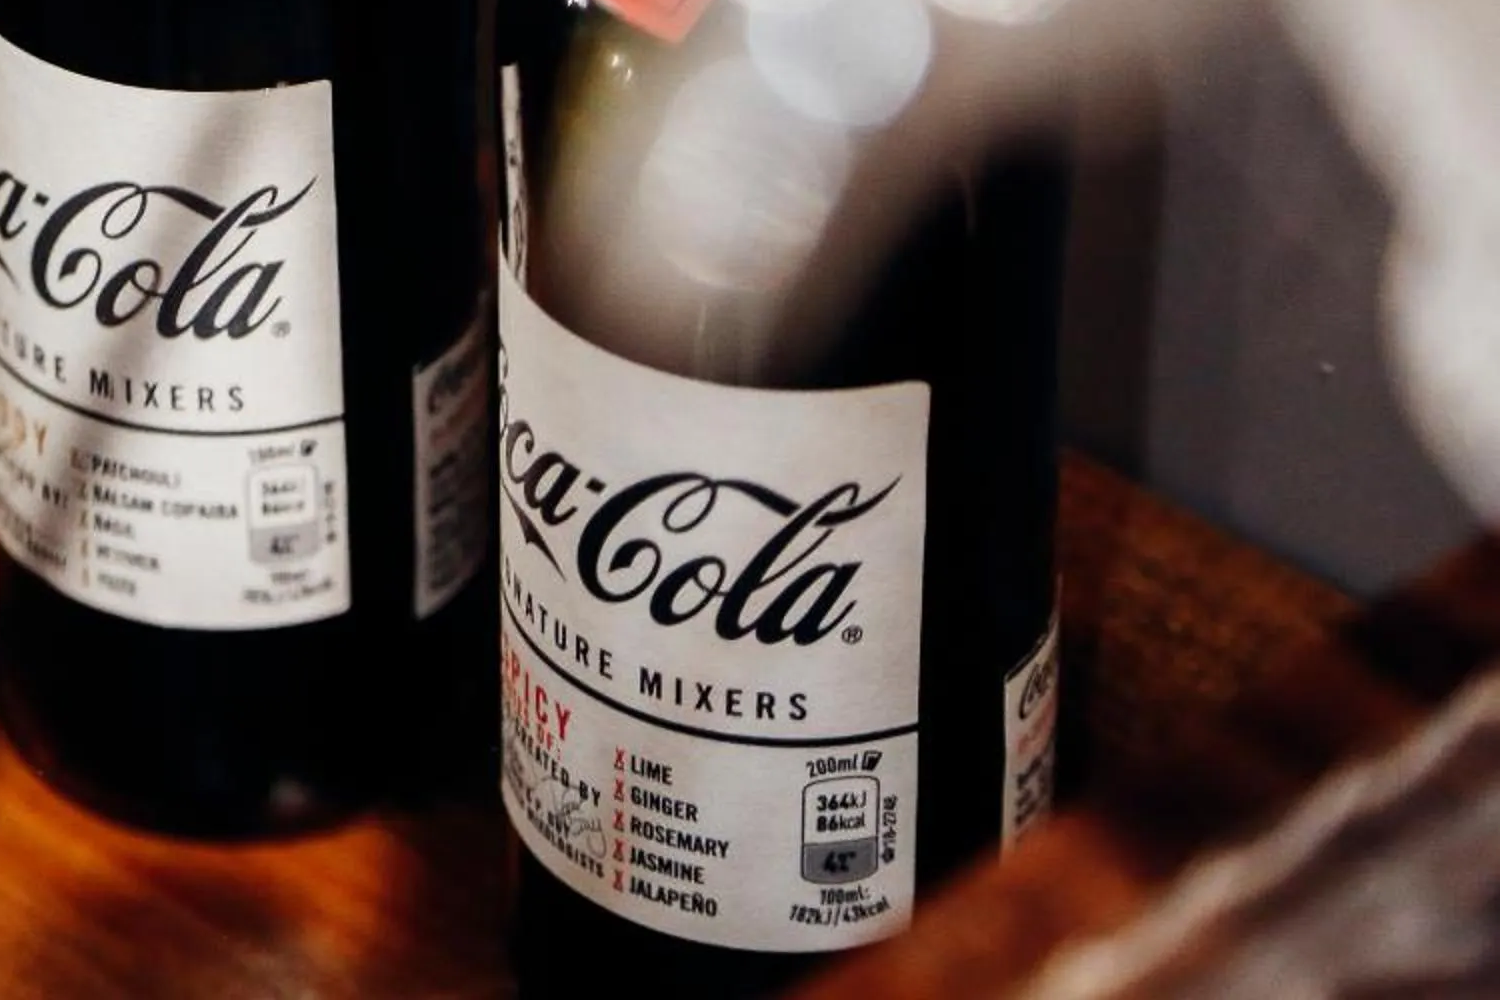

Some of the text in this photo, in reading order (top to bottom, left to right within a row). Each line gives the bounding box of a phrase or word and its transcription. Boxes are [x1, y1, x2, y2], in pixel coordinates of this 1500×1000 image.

[89, 367, 245, 412] MIXERS
[499, 335, 904, 646] ca-Cola
[639, 666, 809, 722] MIXERS
[631, 755, 673, 785] LIME
[806, 753, 858, 779] 200ml
[630, 785, 698, 823] GINGER
[816, 791, 867, 812] 364kJ
[630, 815, 730, 859] ROSEMARY
[816, 813, 866, 832] 86kcal
[630, 847, 705, 885] JASMINE
[629, 875, 718, 918] JALAPEÑO
